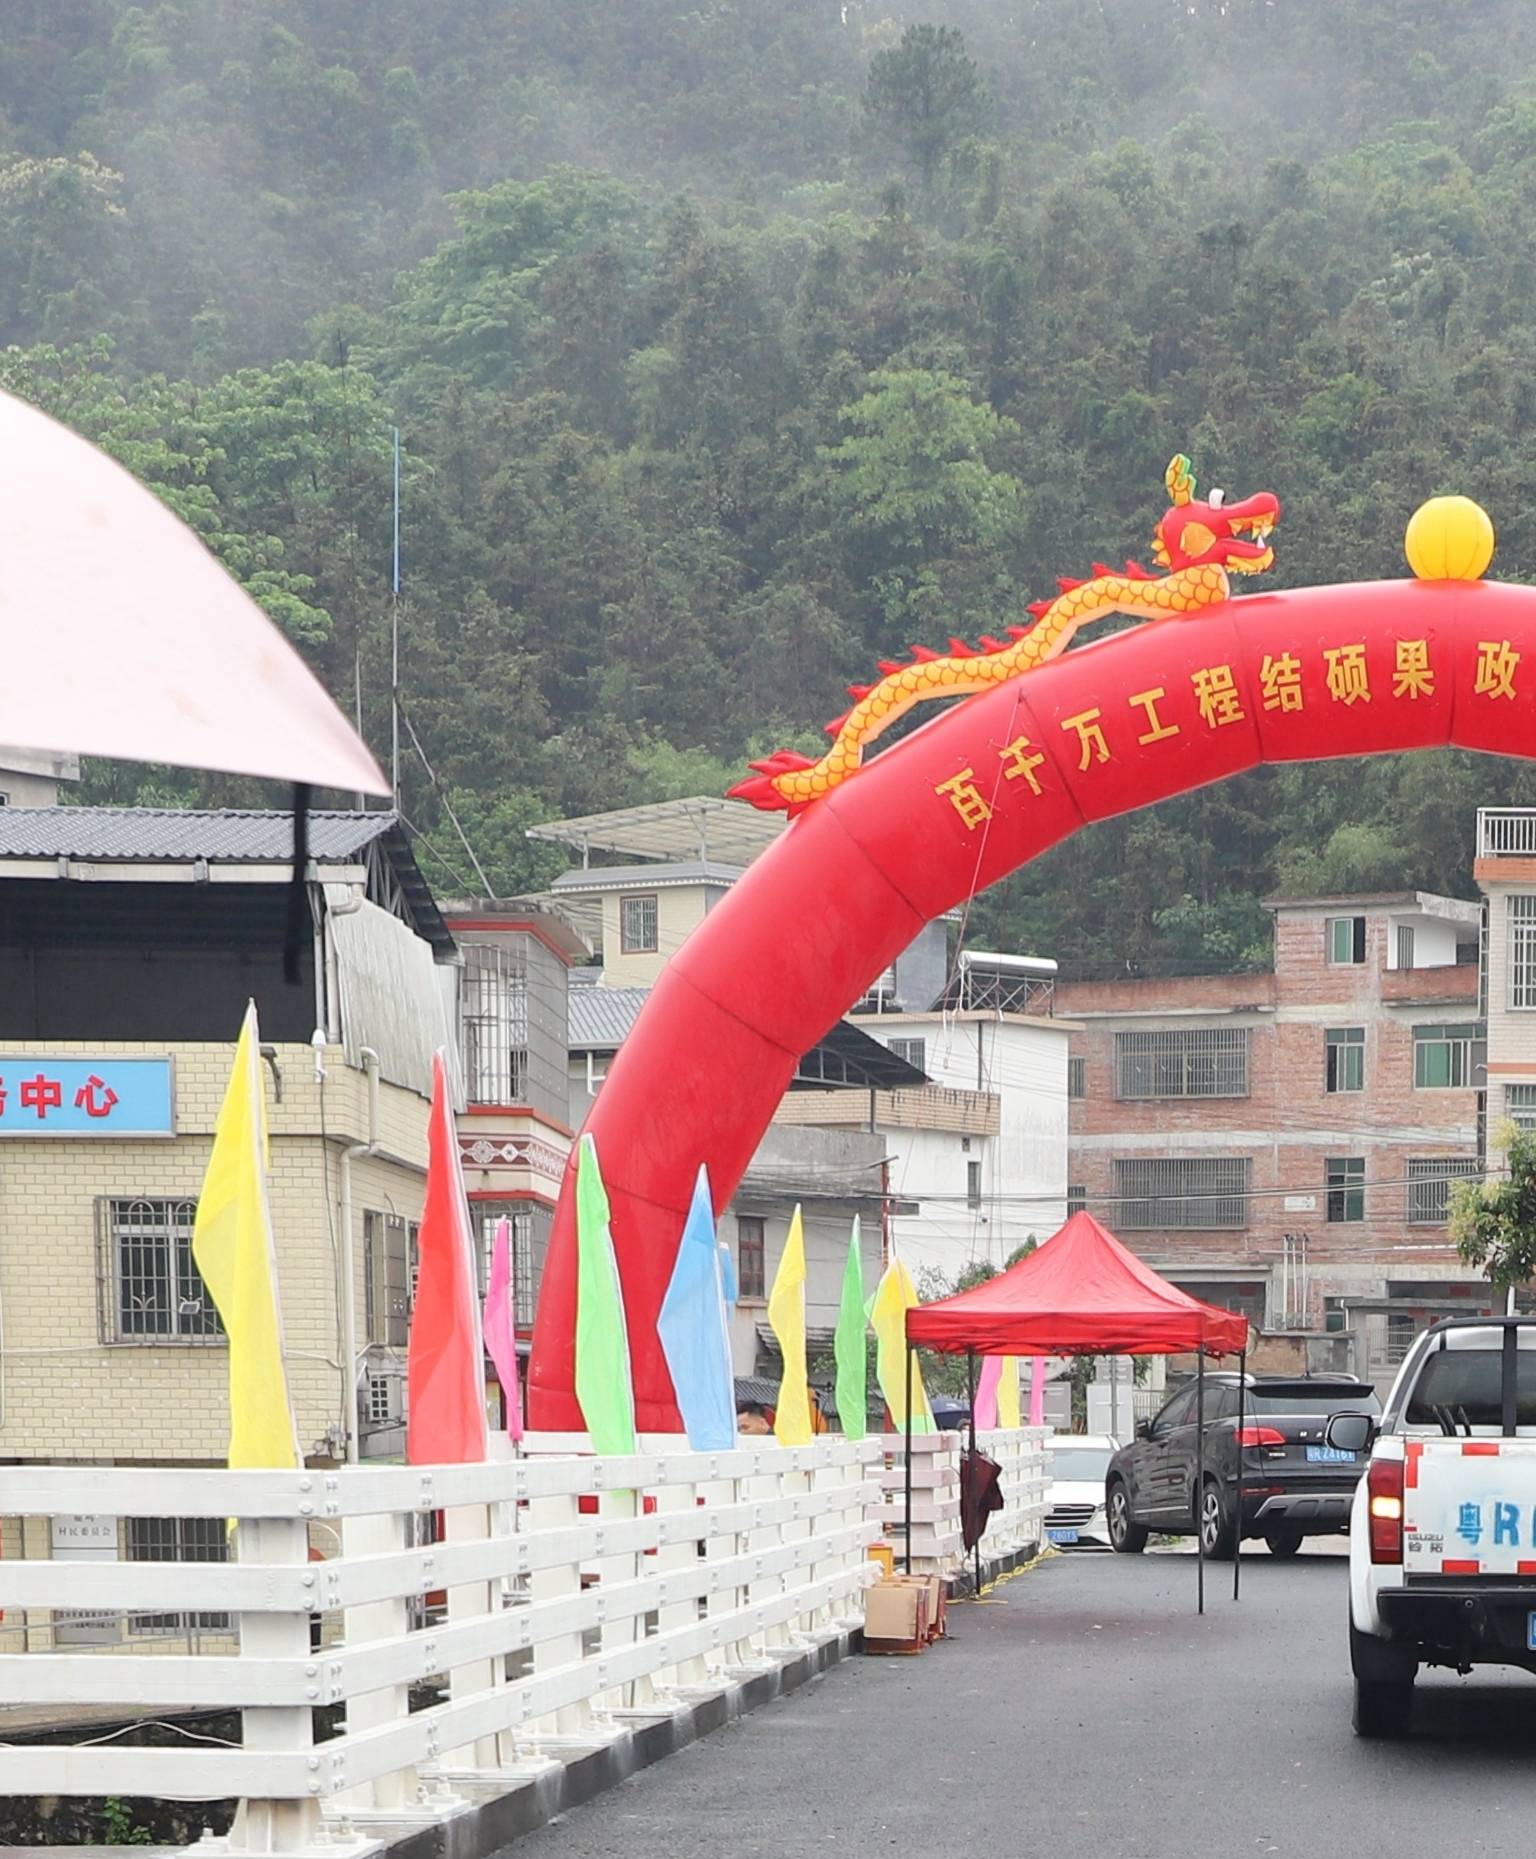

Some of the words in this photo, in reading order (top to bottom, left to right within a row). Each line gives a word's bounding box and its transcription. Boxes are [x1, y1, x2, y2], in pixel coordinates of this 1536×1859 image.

[934, 640, 1436, 830] 百千万工程结硕果
